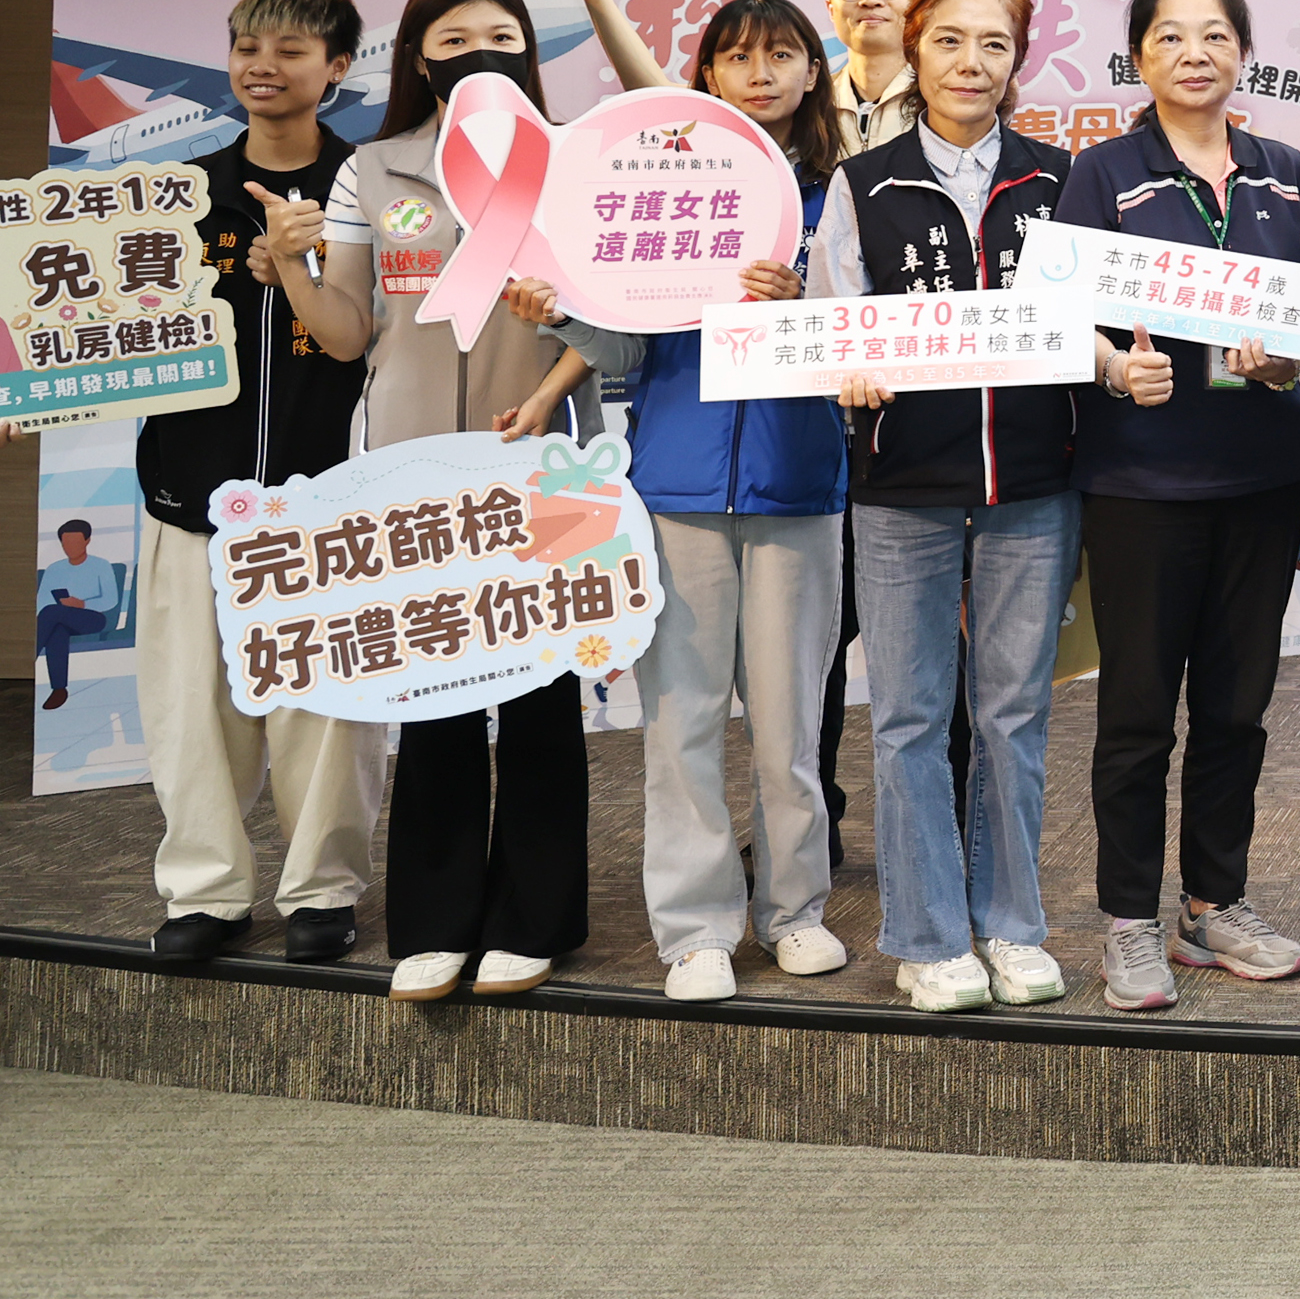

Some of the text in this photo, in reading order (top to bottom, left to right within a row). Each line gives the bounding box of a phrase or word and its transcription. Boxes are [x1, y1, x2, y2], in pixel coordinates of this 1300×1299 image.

[611, 158, 733, 171] 臺南市政府衛生局
[593, 188, 742, 222] 守護女性
[216, 232, 237, 275] 助理
[379, 248, 443, 273] 林依婷
[592, 228, 745, 263] 遠離乳癌
[928, 224, 955, 294] 副主任
[26, 231, 182, 307] 免費
[384, 276, 440, 292] 服務團隊
[1103, 247, 1288, 297] 本市45-74歲
[774, 301, 1039, 336] 本市30-70歲女性
[30, 313, 214, 367] 乳房健檢!
[774, 330, 1065, 367] 完成子宮頸抹片檢查者
[229, 487, 529, 605] 完成篩檢
[243, 558, 648, 698] 好禮等你抽!
